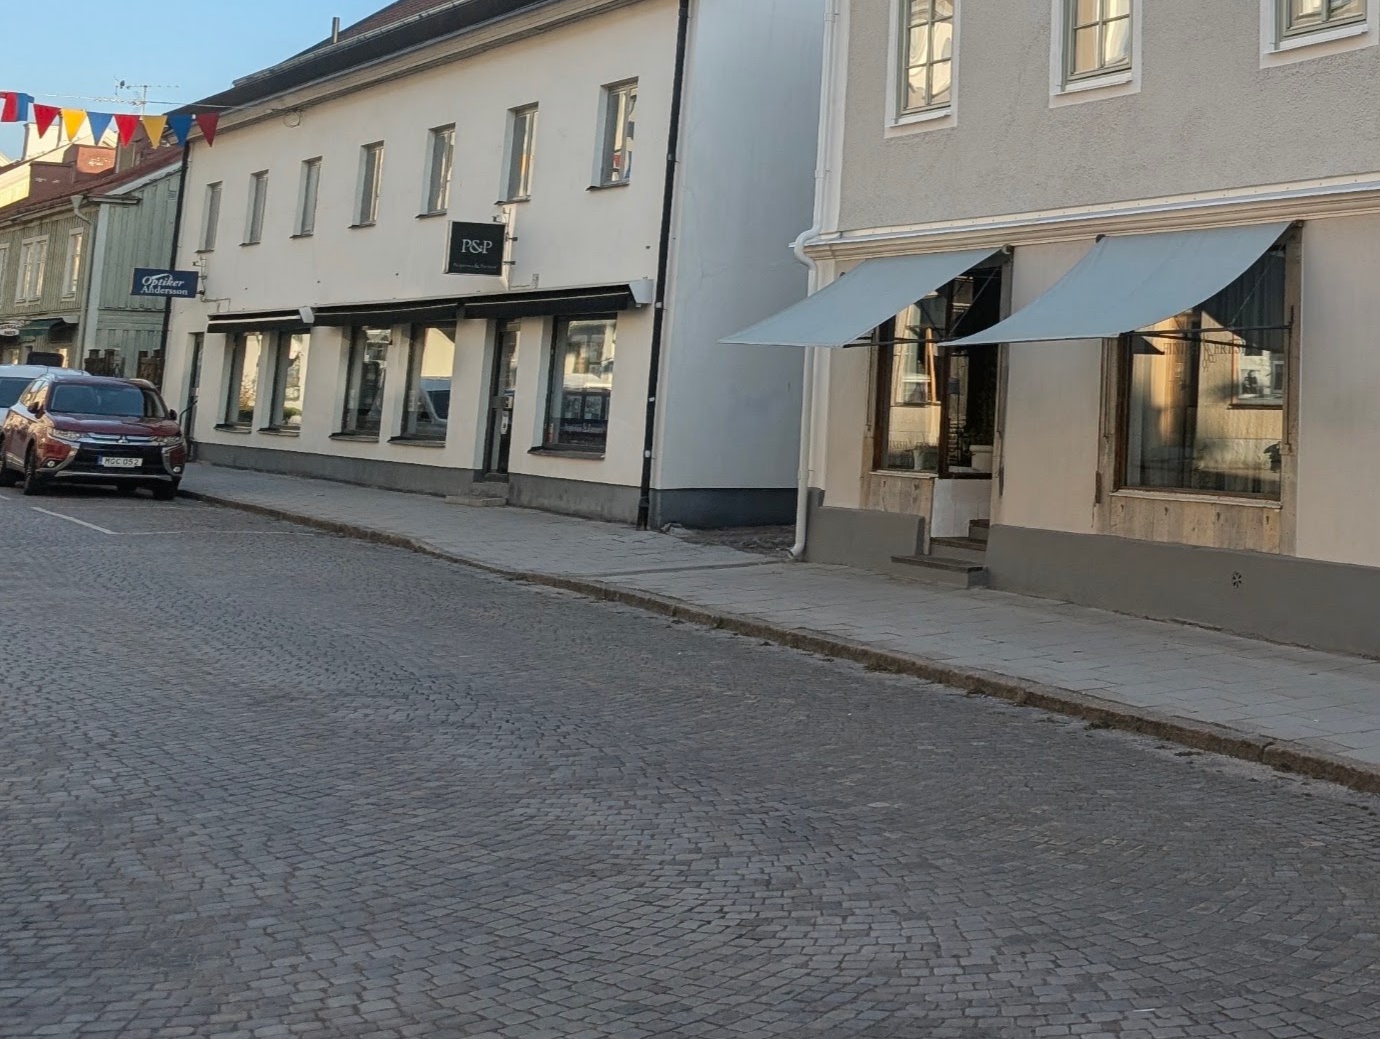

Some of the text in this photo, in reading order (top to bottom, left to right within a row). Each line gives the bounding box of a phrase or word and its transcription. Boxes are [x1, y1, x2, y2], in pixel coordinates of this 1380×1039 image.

[461, 238, 493, 254] P&P
[142, 274, 185, 288] Optiker
[140, 285, 188, 295] Andersson
[104, 457, 139, 466] MGC 052
